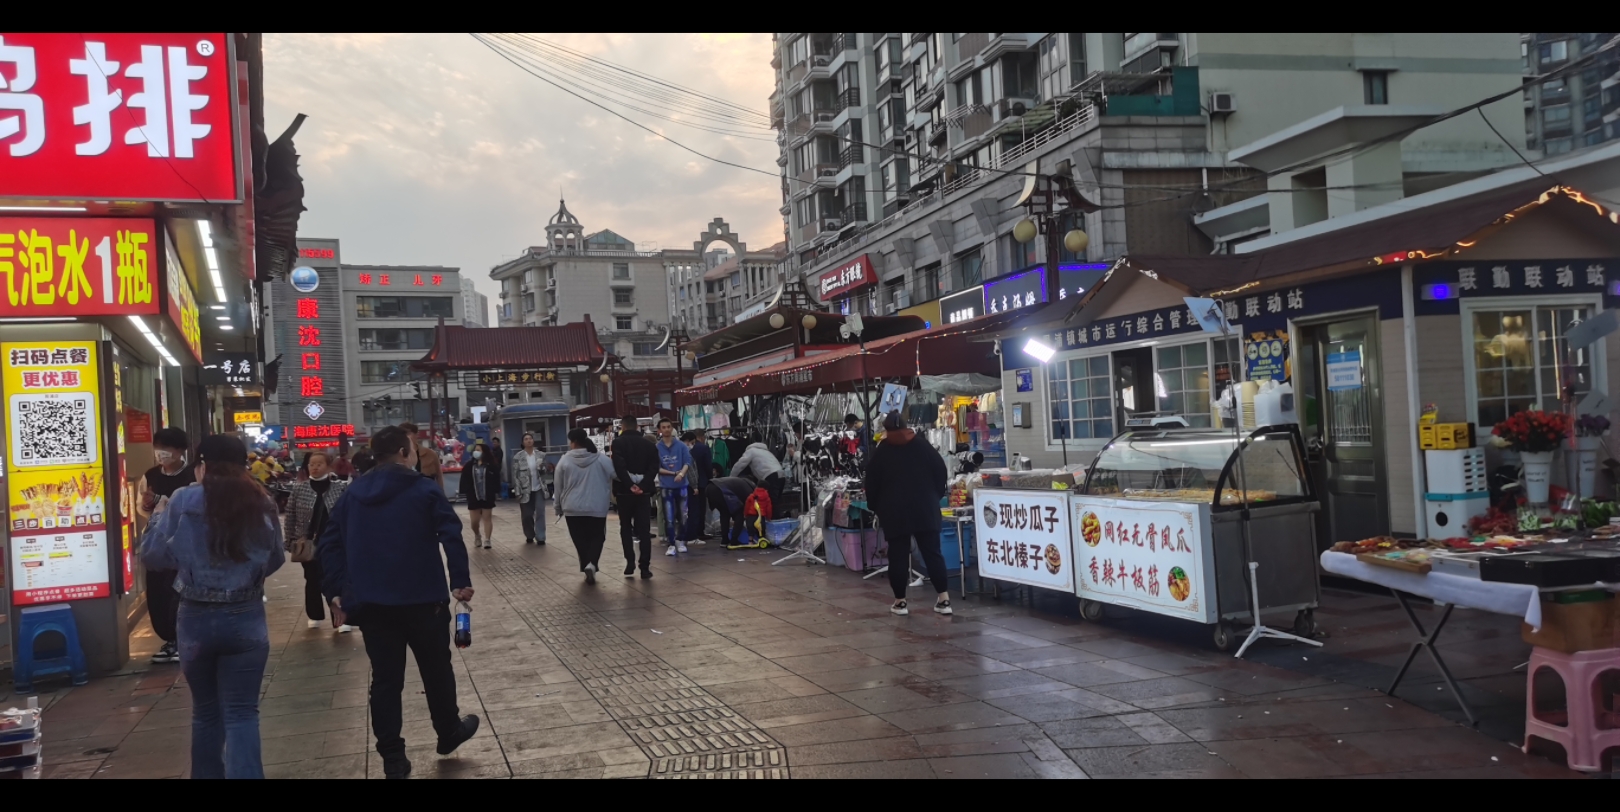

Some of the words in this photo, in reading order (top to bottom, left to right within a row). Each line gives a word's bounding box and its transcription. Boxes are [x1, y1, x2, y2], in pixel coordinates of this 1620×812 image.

[1459, 264, 1605, 290] 联勤联动站
[10, 349, 88, 366] 扫码点餐
[297, 297, 324, 397] 康沈口腔
[23, 371, 79, 388] 更优惠
[203, 359, 251, 374] 一号店
[482, 372, 556, 383] 小上海步行街
[999, 503, 1059, 534] 现炒瓜子
[1104, 521, 1192, 554] 网红无骨凤爪
[986, 538, 1044, 570] 东北榛子
[1088, 556, 1161, 597] 香辣牛板筋
